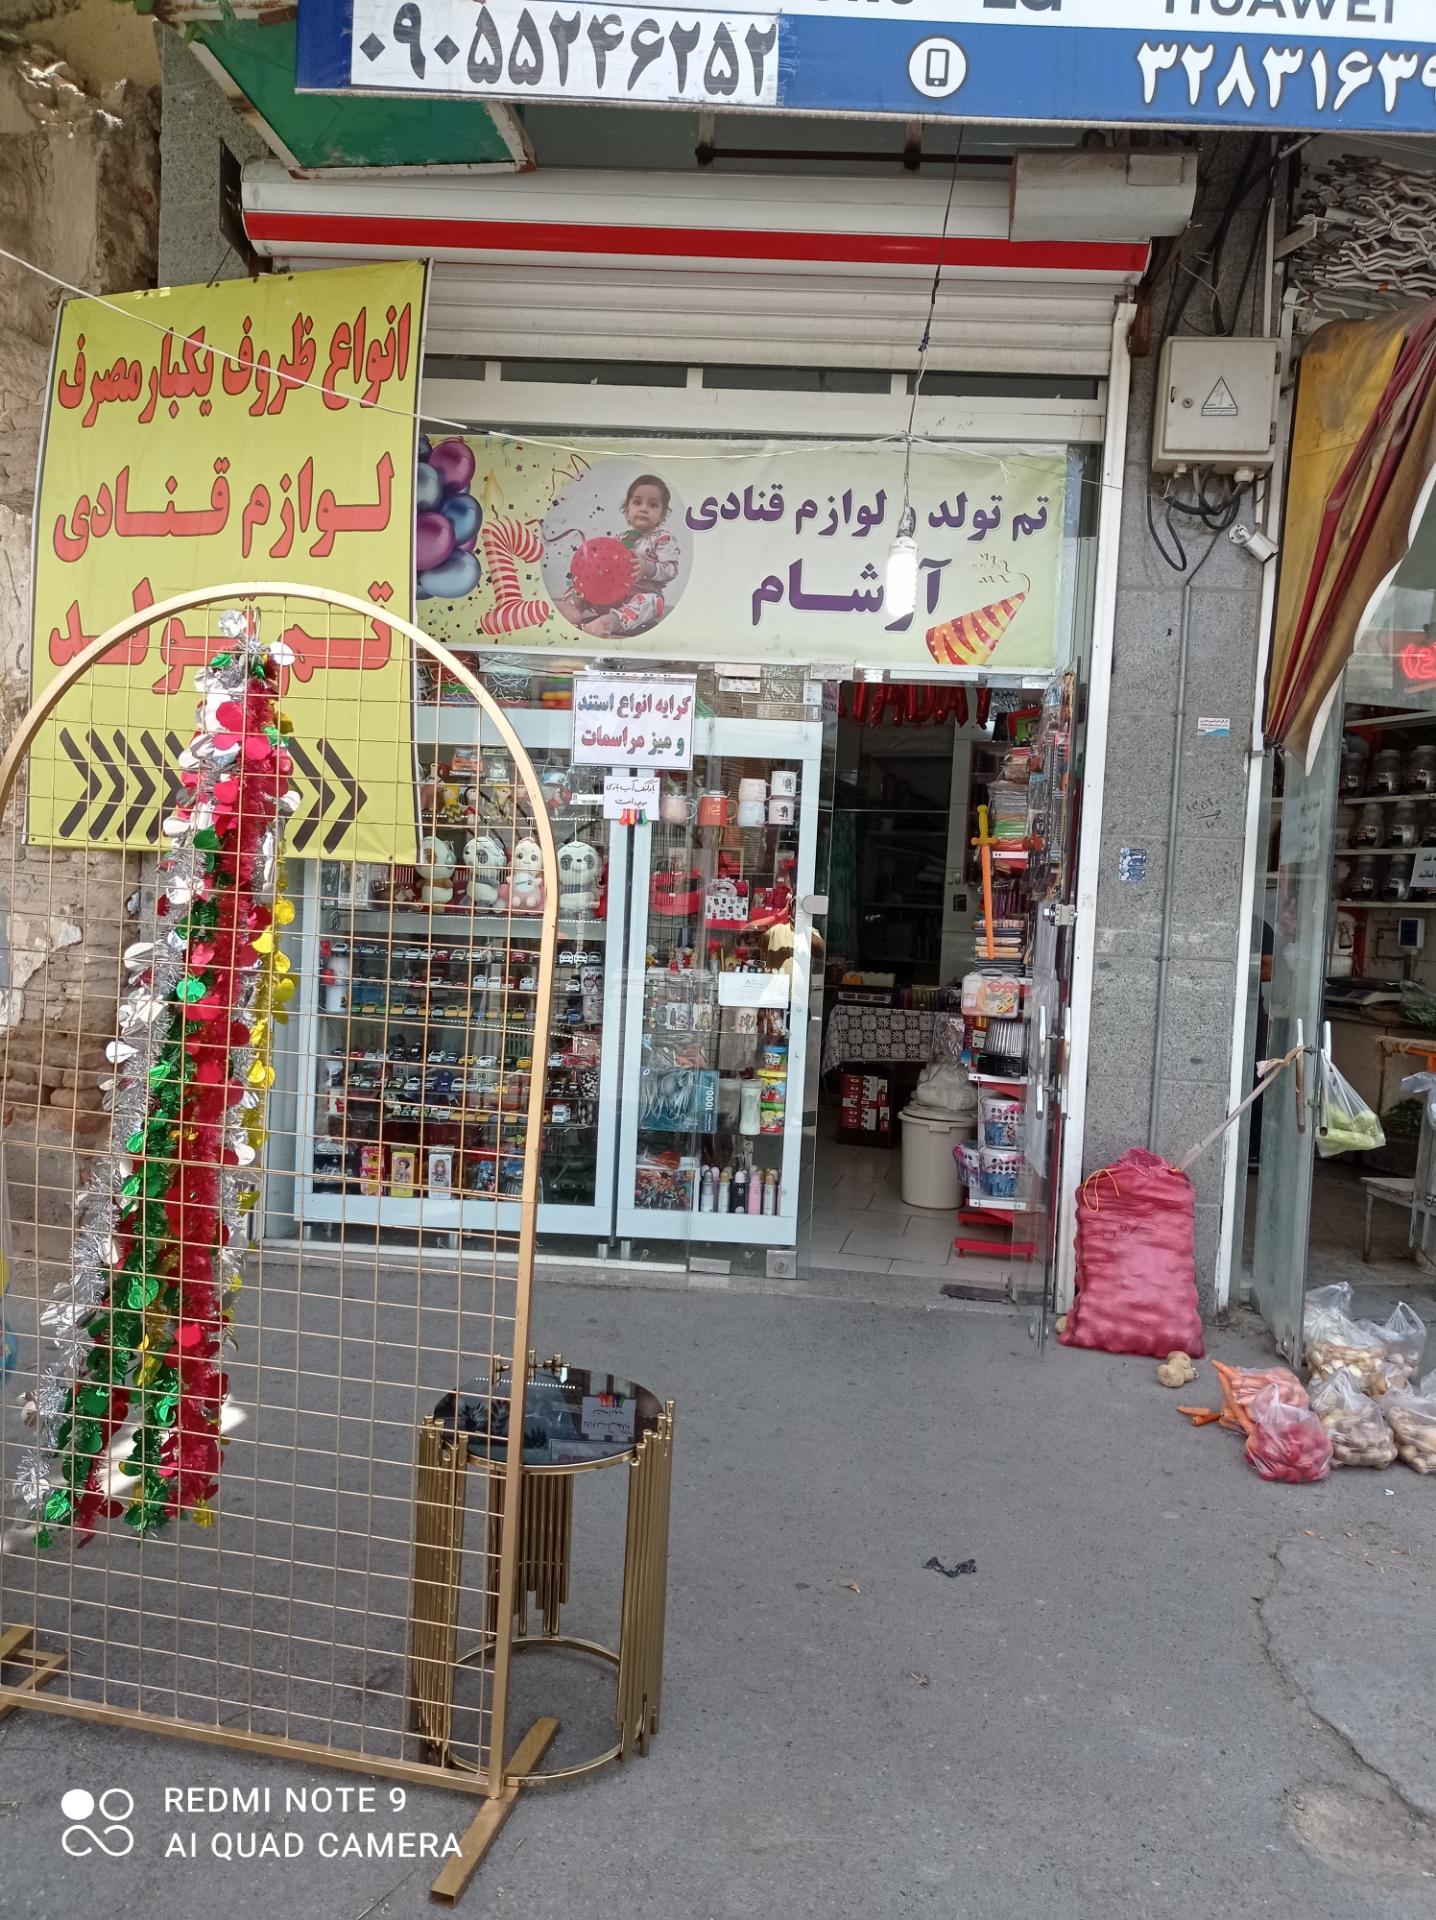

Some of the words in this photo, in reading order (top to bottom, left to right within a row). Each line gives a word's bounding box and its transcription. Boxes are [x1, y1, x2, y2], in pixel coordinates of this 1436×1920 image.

[359, 1, 777, 97] ۰۹۰۵۵۲۴۶۲۵۲
[221, 312, 317, 417] ظروف
[322, 302, 411, 411] انواع
[53, 456, 231, 563] قنادی
[242, 451, 395, 559] لوازم
[685, 484, 784, 531] قنادی
[796, 488, 887, 537] لوازم
[928, 491, 1003, 541] تولد
[1012, 496, 1050, 541] تم
[617, 693, 652, 718] انواع
[655, 694, 692, 720] کرایه
[648, 732, 672, 755] میز
[675, 737, 685, 756] و
